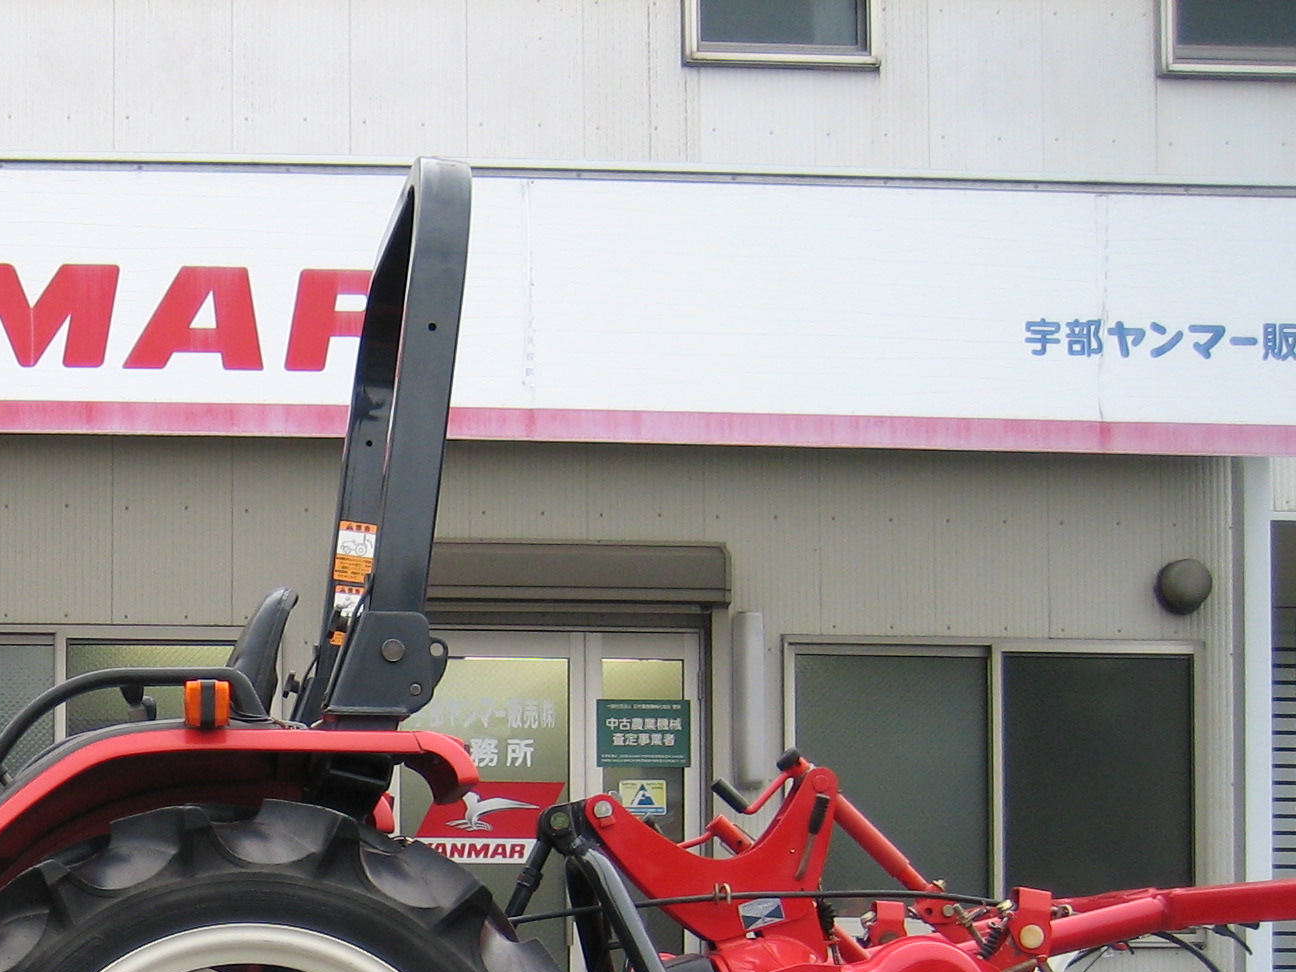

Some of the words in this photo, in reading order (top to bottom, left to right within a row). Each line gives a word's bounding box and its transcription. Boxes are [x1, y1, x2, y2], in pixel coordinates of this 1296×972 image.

[1024, 317, 1296, 361] 宇部ヤンマー販
[605, 717, 682, 731] 中古農業機械
[612, 732, 675, 746] 査定事業者
[427, 842, 526, 859] ANMAR
